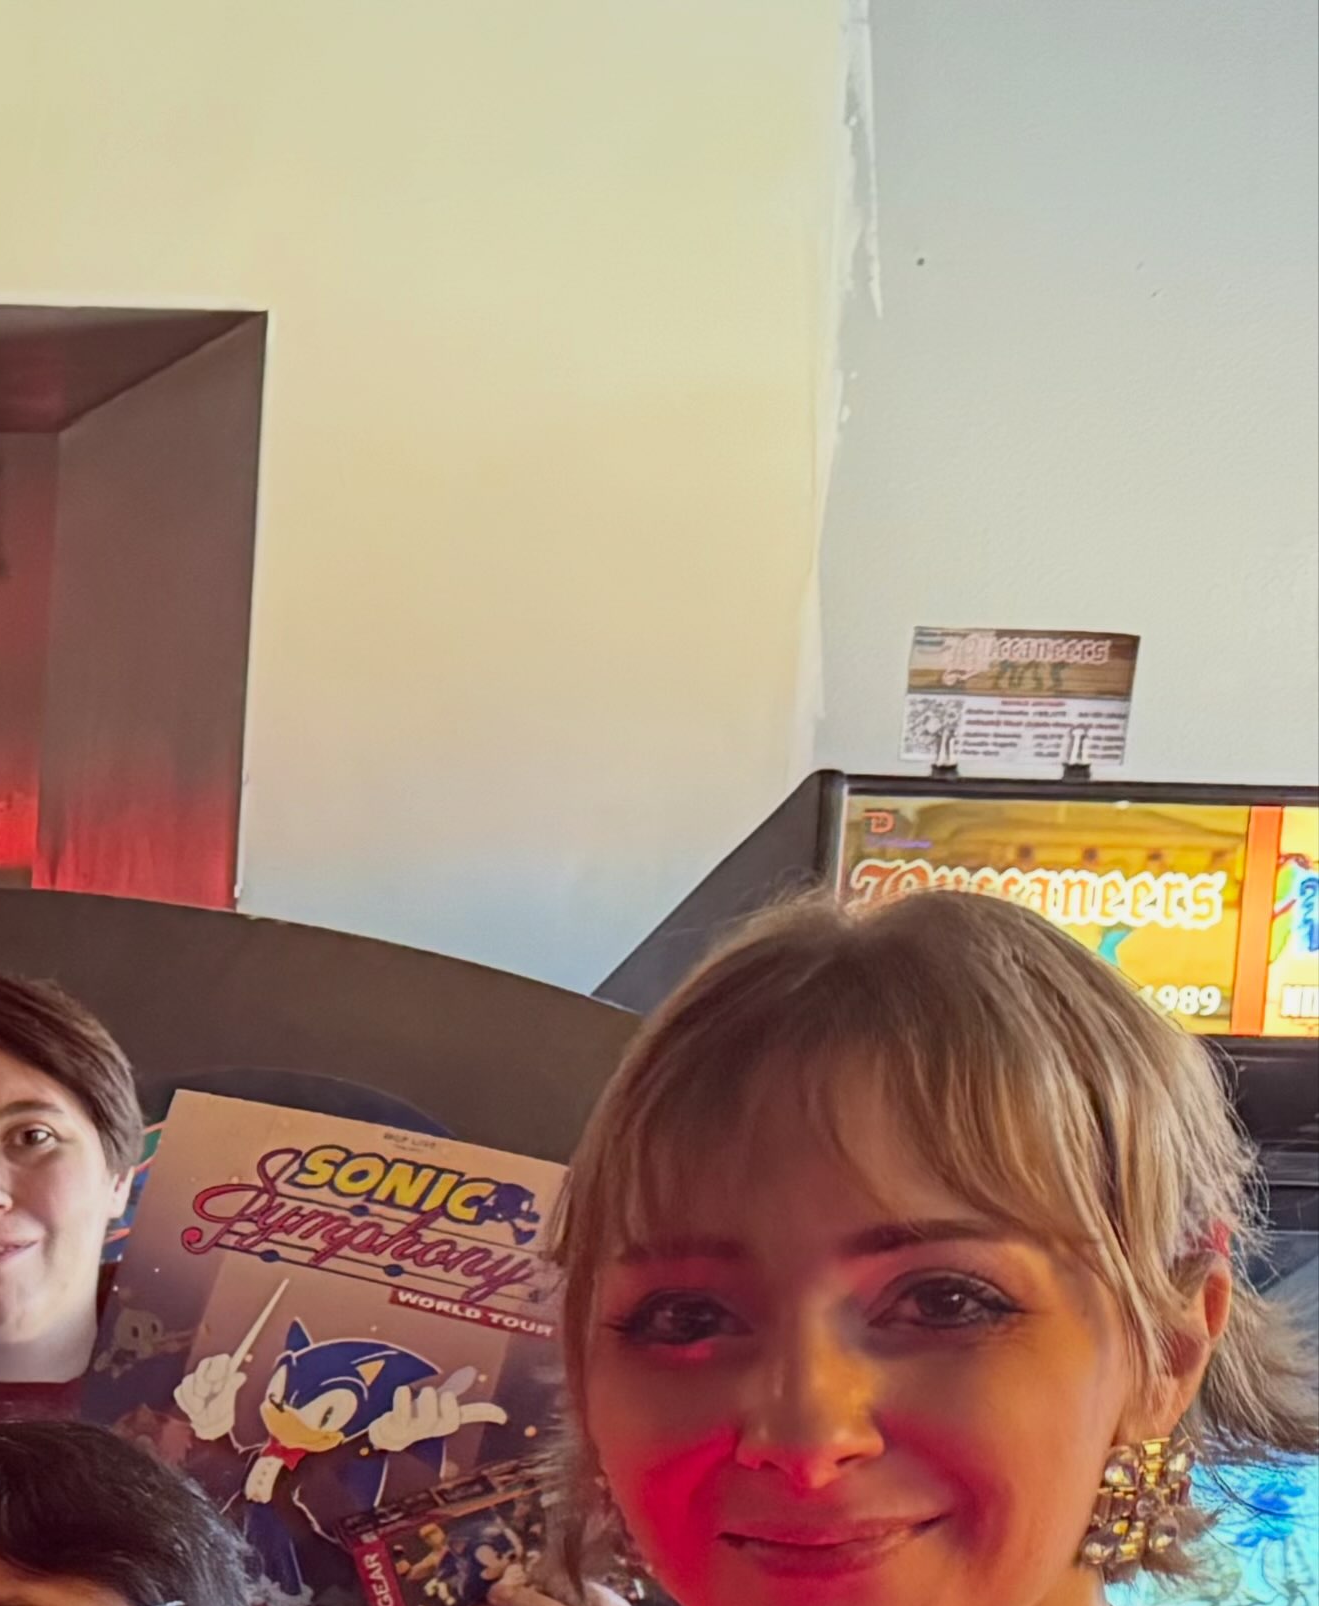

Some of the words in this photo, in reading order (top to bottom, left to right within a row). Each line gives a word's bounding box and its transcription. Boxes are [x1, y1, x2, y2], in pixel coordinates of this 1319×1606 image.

[284, 1144, 502, 1226] SONIC
[181, 1148, 536, 1305] Symphony
[397, 1290, 482, 1321] WORLD
[487, 1311, 554, 1337] TOUR
